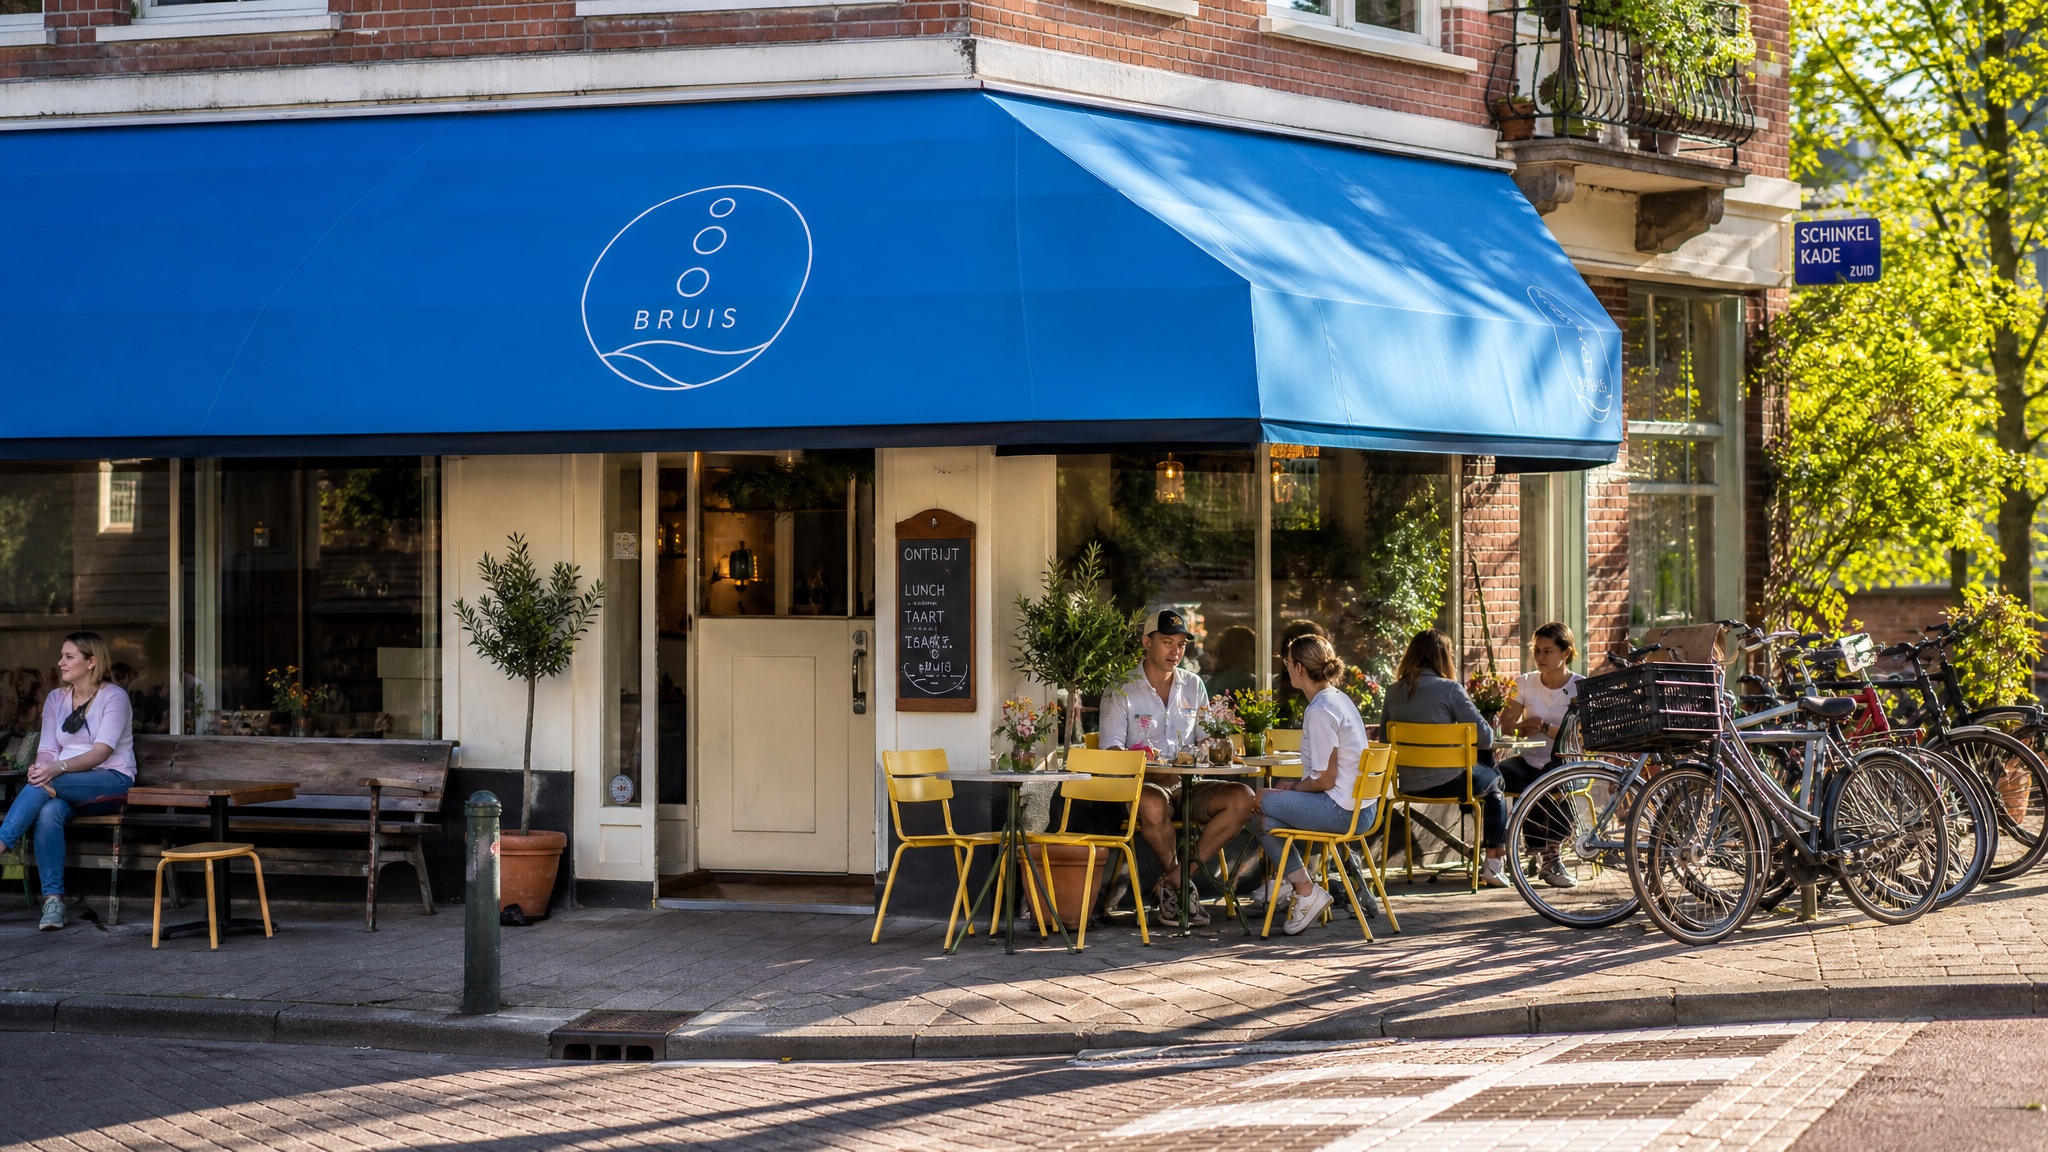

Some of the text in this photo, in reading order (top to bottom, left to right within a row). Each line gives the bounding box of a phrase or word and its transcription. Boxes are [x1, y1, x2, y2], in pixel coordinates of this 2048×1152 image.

[1800, 225, 1874, 244] SCHINKEL
[1801, 247, 1841, 265] KADE
[1850, 265, 1874, 277] ZUID
[634, 307, 737, 330] BRUIS
[904, 547, 960, 561] ONTBIJT
[905, 584, 945, 596] LUNCH
[904, 610, 945, 623] TAART
